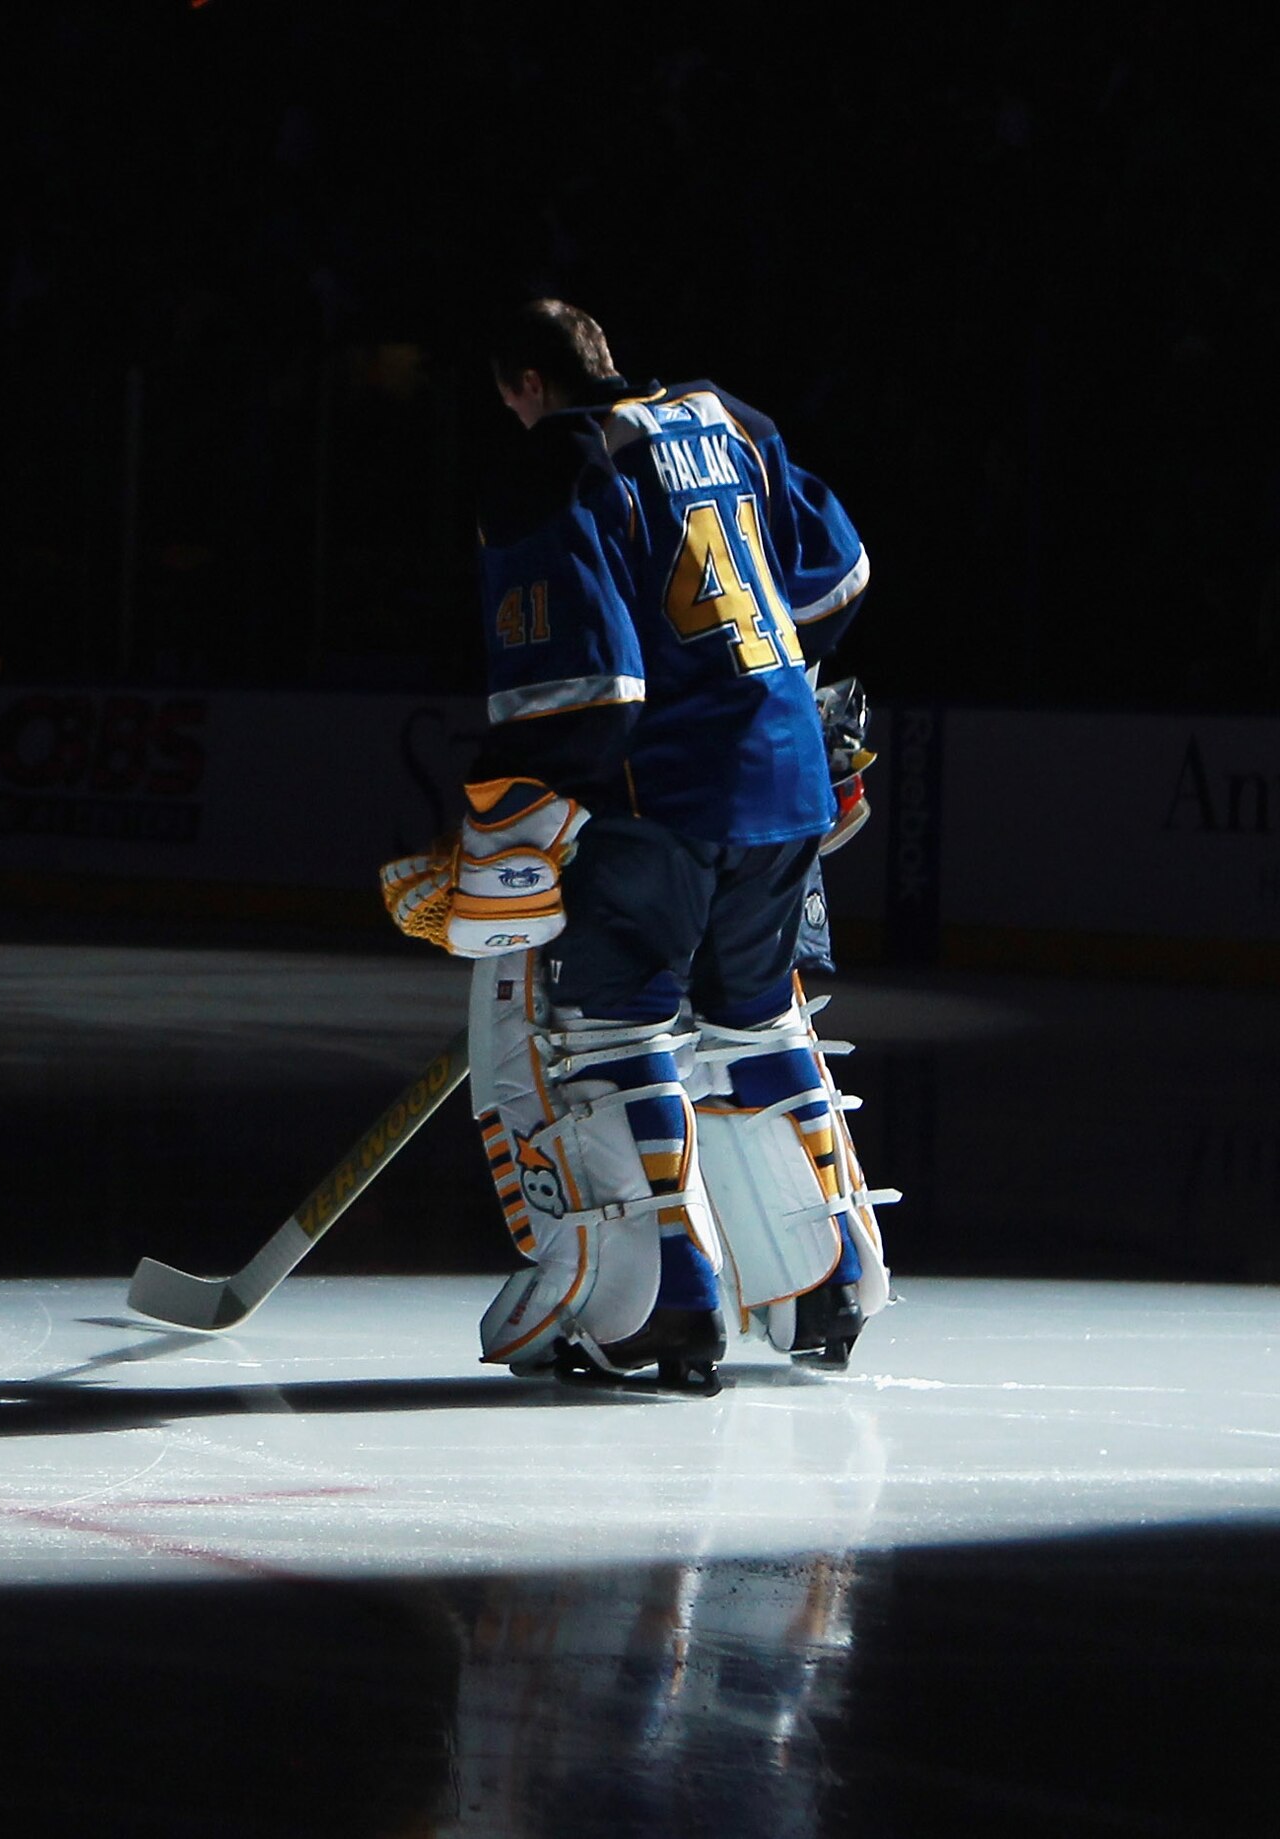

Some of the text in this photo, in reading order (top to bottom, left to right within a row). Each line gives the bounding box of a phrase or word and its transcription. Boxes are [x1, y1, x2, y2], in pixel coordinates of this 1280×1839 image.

[650, 434, 740, 492] HALAK
[496, 580, 551, 649] 41
[662, 494, 806, 677] 41
